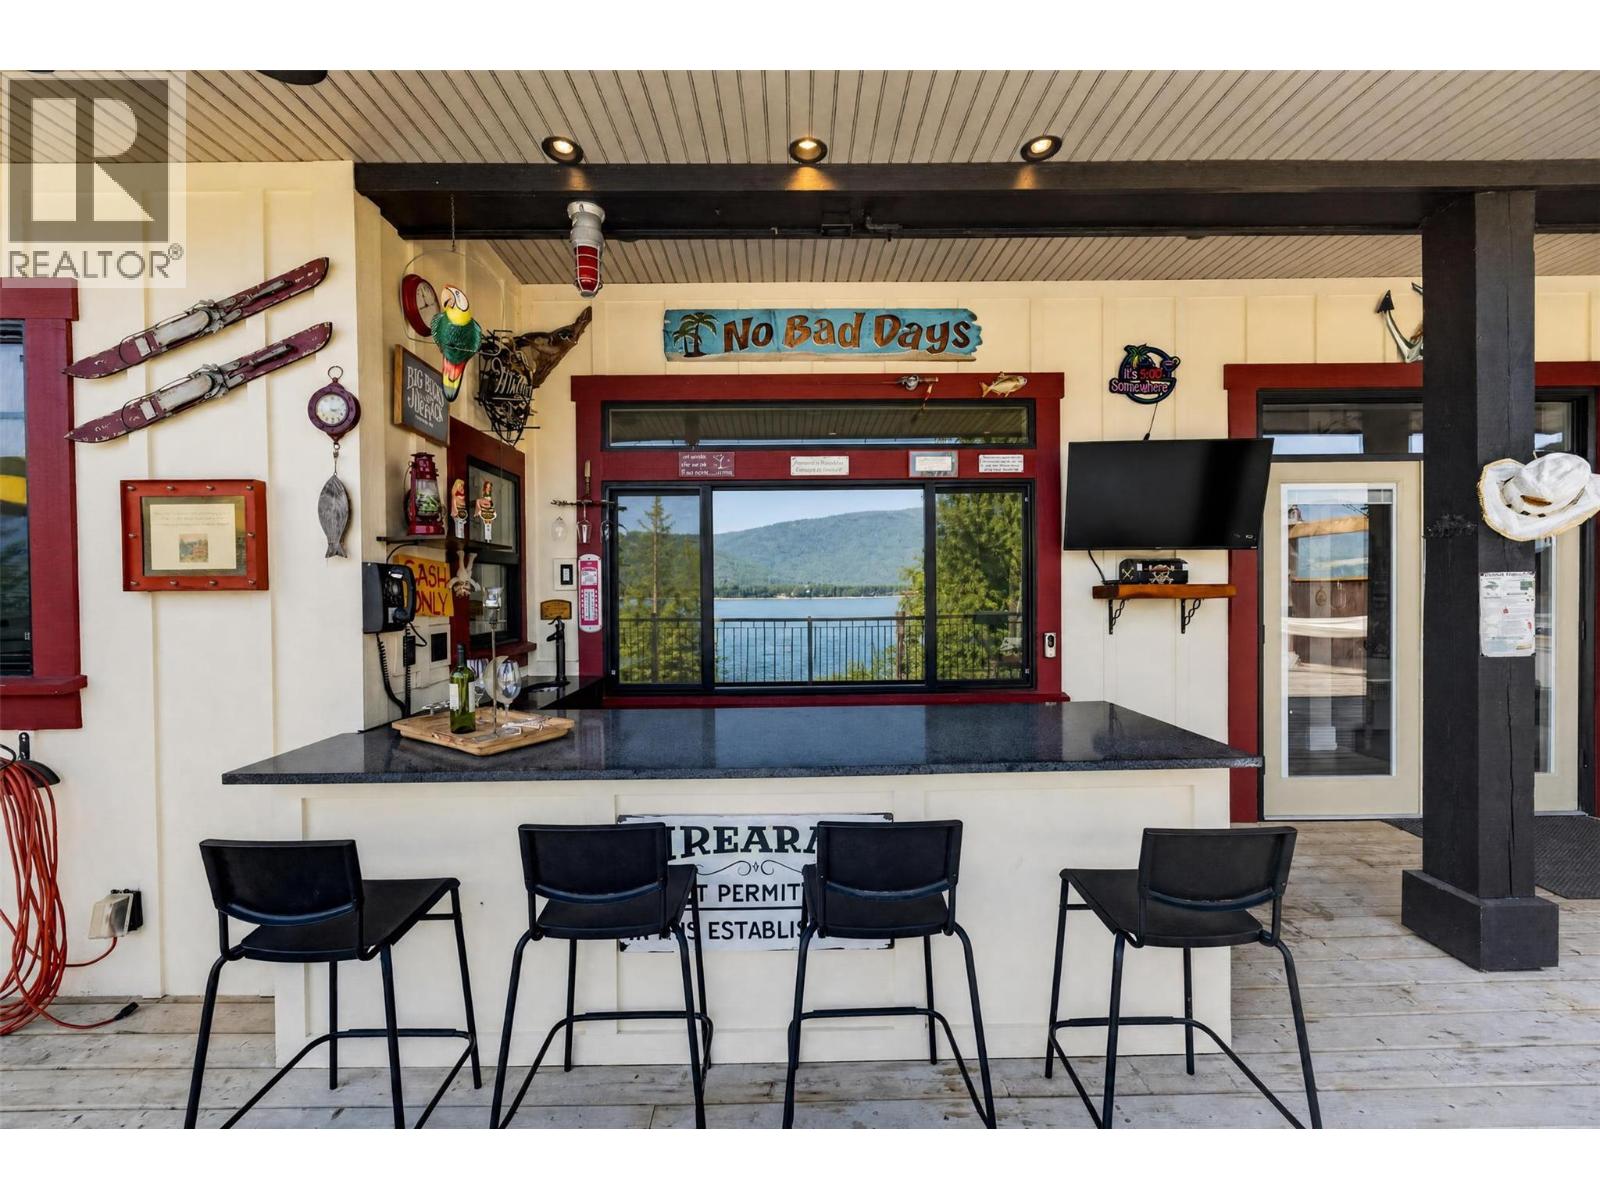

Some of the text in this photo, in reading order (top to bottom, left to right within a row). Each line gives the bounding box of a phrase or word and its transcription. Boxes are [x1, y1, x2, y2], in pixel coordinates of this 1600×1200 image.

[723, 311, 972, 355] No Bad Days
[407, 366, 423, 390] BIG
[1123, 367, 1162, 380] It's 5:00
[1111, 379, 1168, 393] Somewhere
[665, 826, 818, 861] IREAR
[718, 883, 804, 903] PERMIT
